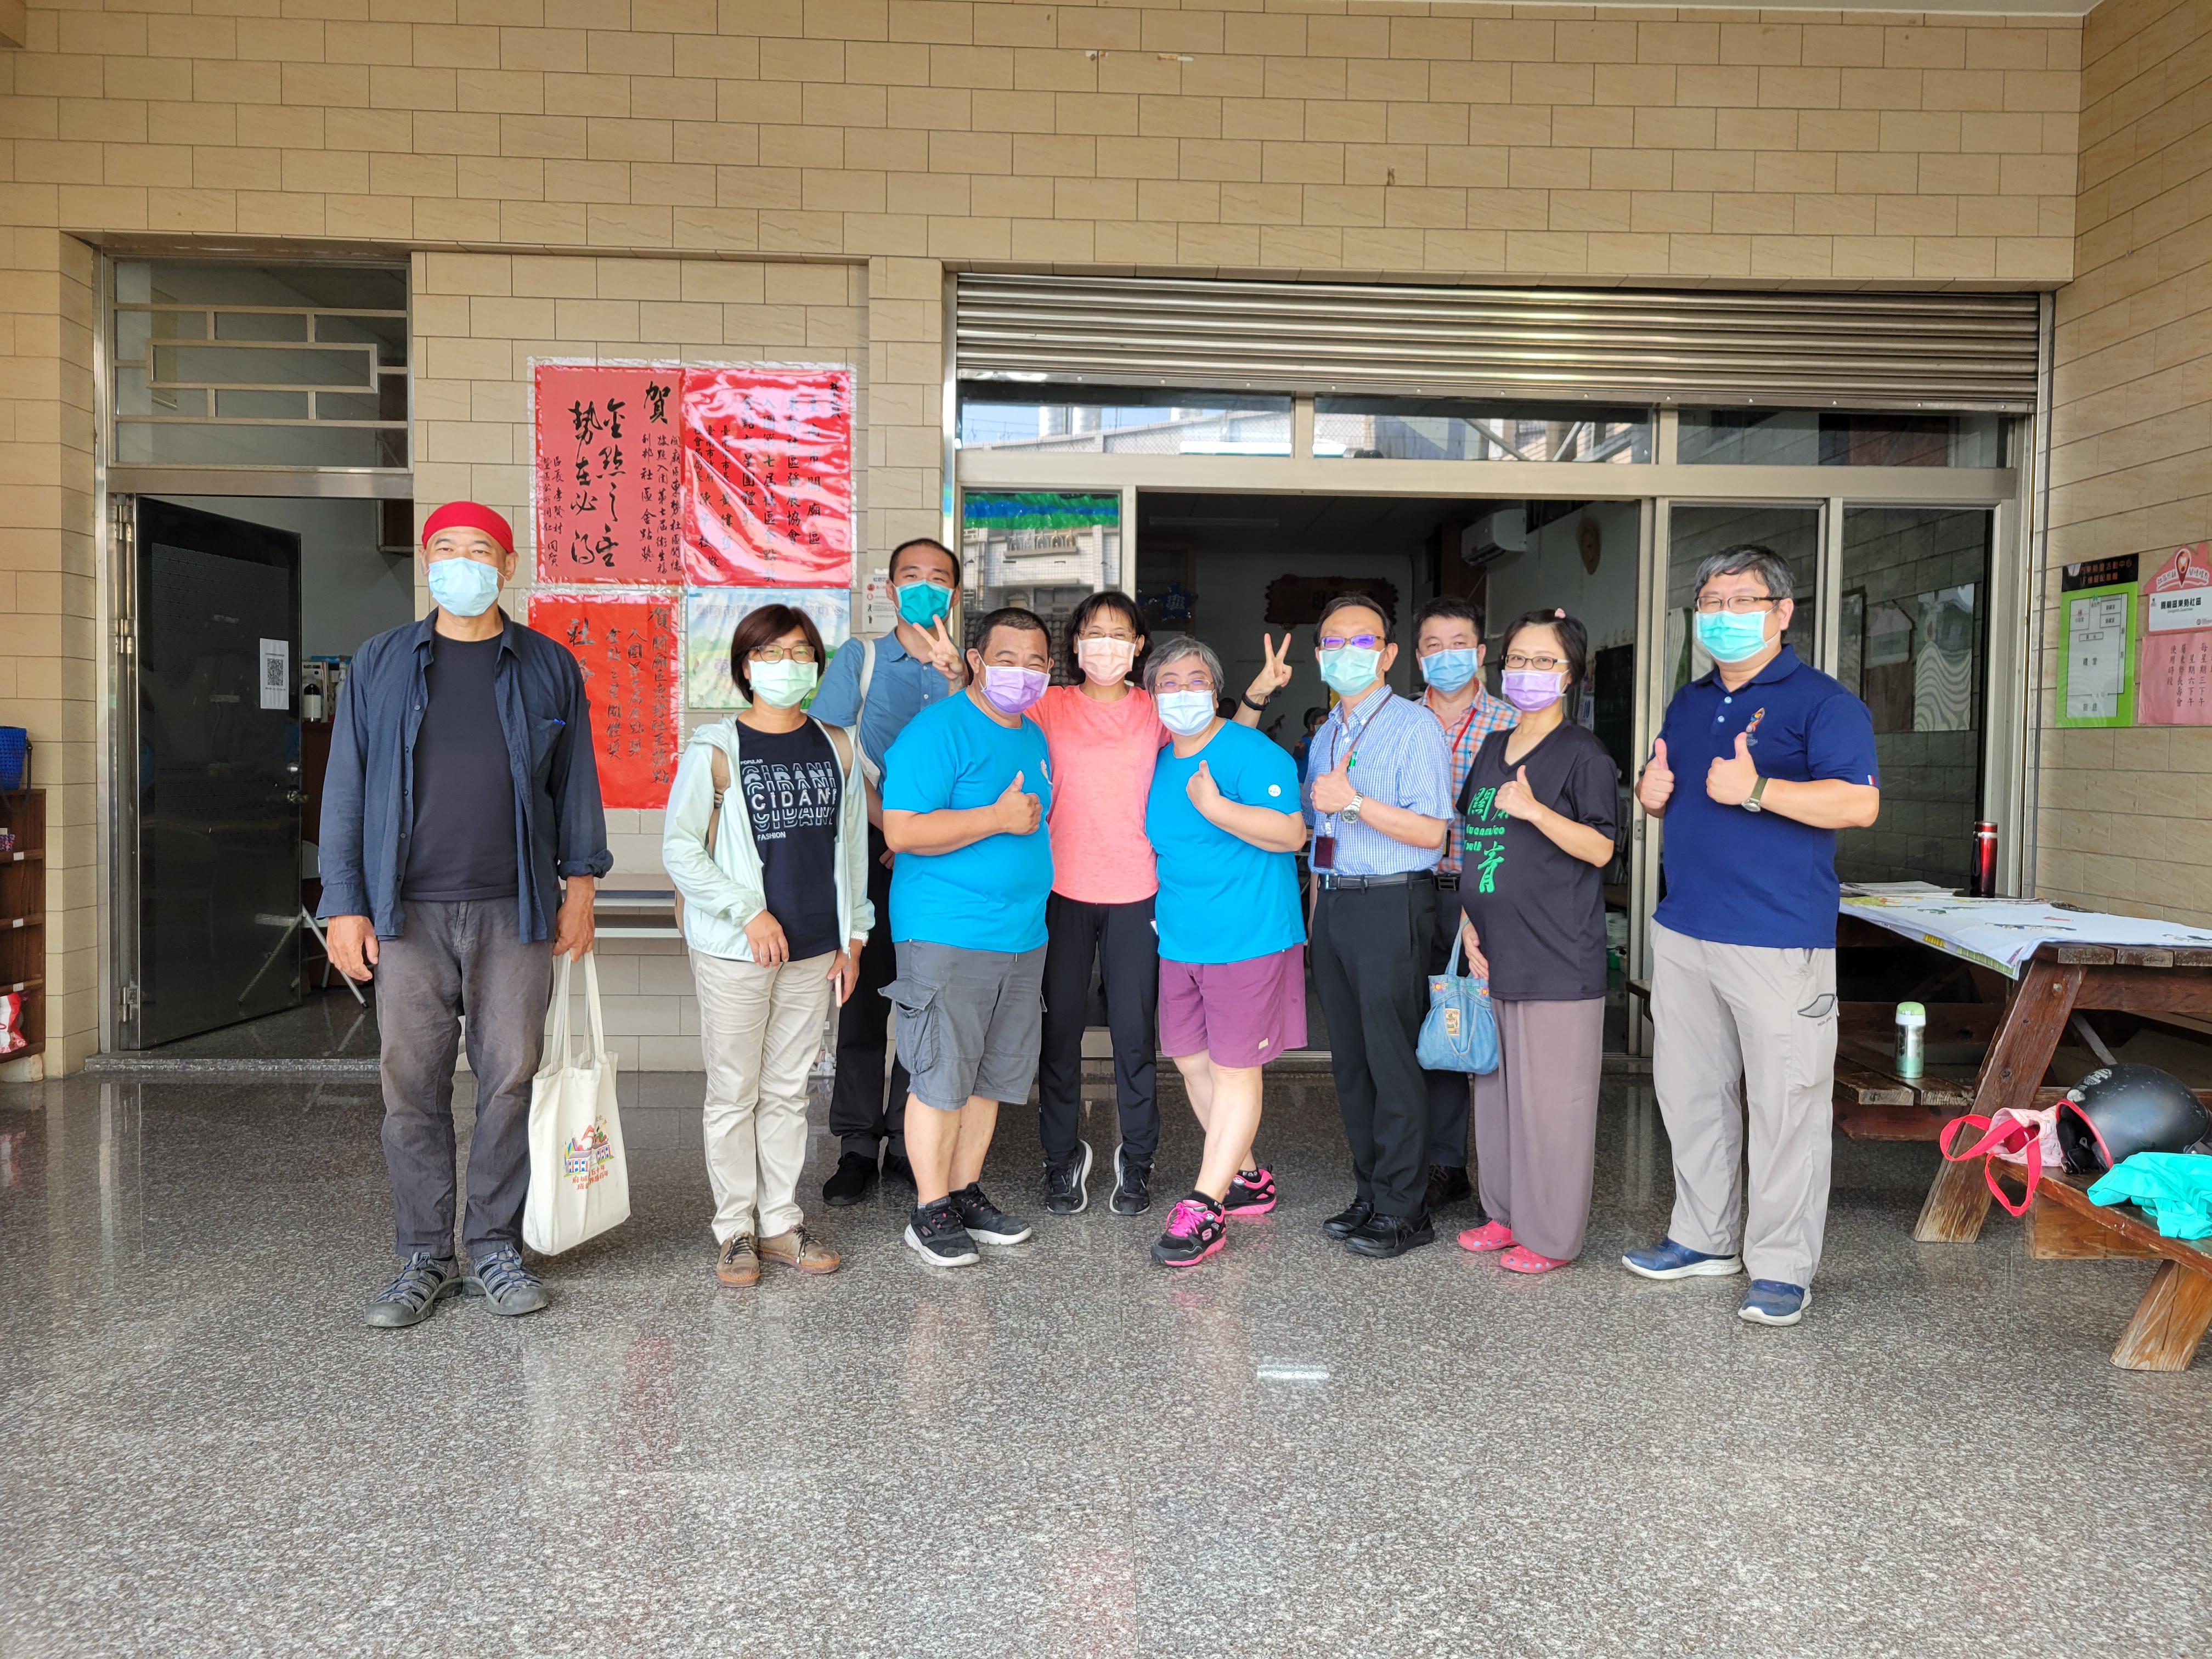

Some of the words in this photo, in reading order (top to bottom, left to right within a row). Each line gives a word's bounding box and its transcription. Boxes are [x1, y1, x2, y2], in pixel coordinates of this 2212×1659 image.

[644, 381, 671, 425] 賀
[2187, 653, 2196, 707] 星期六下午
[2199, 642, 2208, 707] 每星期三下午
[751, 787, 837, 811] CIDANI
[757, 831, 786, 842] FASHION
[1477, 840, 1505, 894] 青
